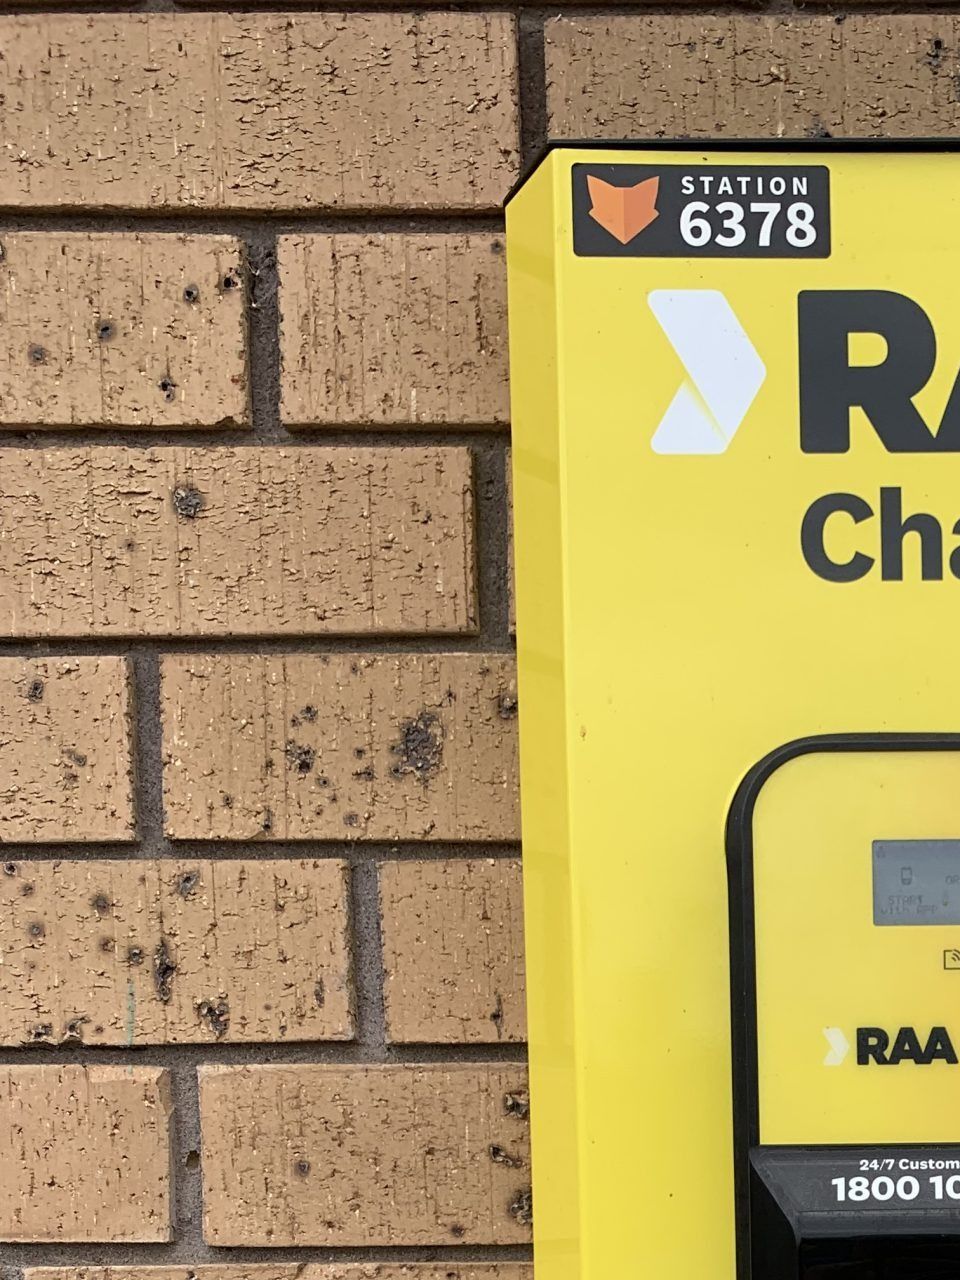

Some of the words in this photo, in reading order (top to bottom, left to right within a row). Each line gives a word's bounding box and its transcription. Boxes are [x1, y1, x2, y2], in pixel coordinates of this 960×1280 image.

[681, 175, 809, 197] STATION
[679, 200, 817, 249] 6378
[856, 1027, 958, 1065] RAA
[859, 1159, 895, 1171] 24/7
[832, 1176, 919, 1201] 1800
